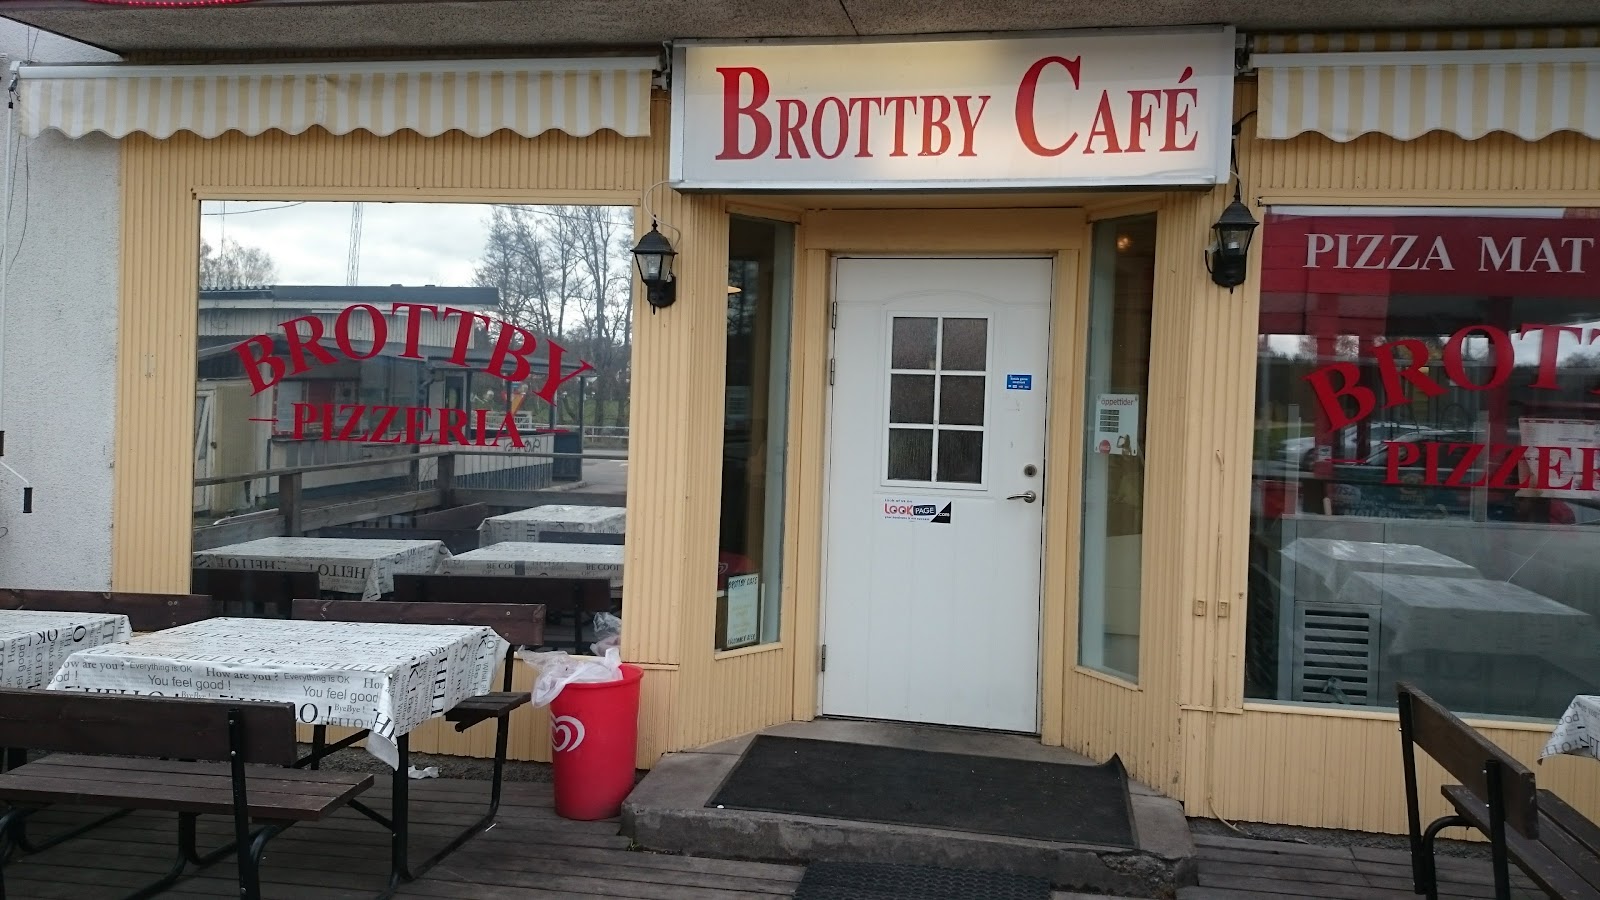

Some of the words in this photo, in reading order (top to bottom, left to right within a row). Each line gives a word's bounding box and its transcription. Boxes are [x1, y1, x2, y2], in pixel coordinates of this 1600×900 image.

[716, 66, 991, 160] BROTTBY
[1015, 55, 1198, 158] CAFÉ
[1302, 233, 1455, 271] PIZZA
[1478, 236, 1594, 274] MAT
[231, 302, 594, 407] BROTTBY
[1302, 322, 1600, 433] BROT
[1101, 397, 1134, 406] öppettider
[292, 403, 526, 448] PIZZERIA
[82, 660, 97, 669] are
[100, 661, 118, 673] you
[130, 661, 170, 673] Everything
[180, 665, 193, 673] OK
[148, 675, 168, 687] You
[172, 676, 192, 688] feel
[196, 680, 224, 692] good
[206, 667, 231, 678] How
[234, 672, 250, 680] are
[253, 673, 272, 683] you
[284, 673, 327, 684] Everything
[303, 685, 323, 698] You
[326, 687, 347, 700] feel
[334, 704, 360, 716] ByeBye
